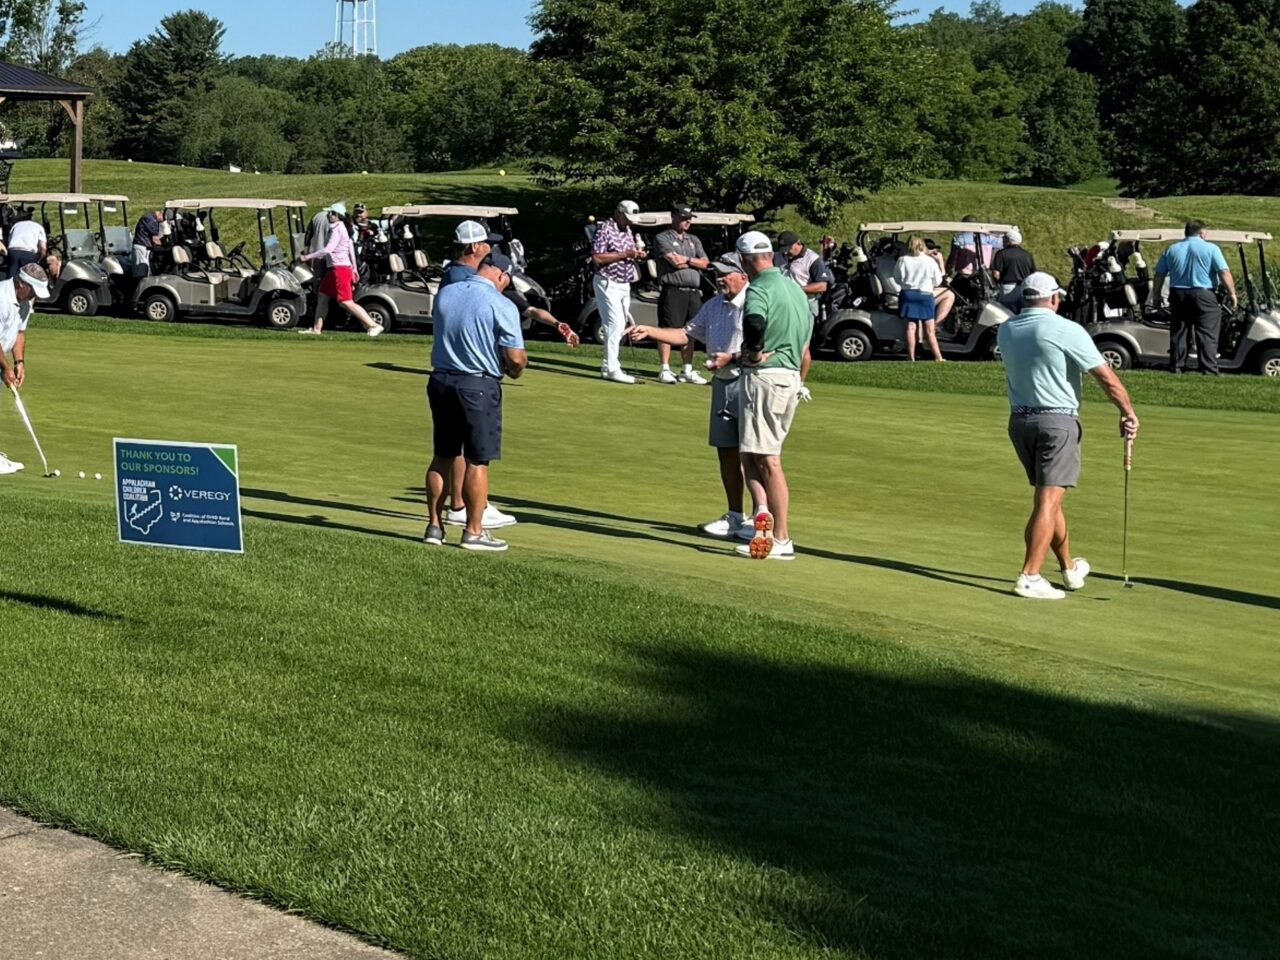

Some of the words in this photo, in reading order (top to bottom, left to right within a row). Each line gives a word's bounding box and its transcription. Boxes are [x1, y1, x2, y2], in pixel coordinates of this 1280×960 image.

[120, 449, 153, 460] THANK
[154, 451, 176, 462] YOU
[177, 453, 192, 462] TO
[120, 462, 141, 472] OUR
[143, 464, 199, 476] SPONSORS!
[184, 489, 231, 501] VEREGY
